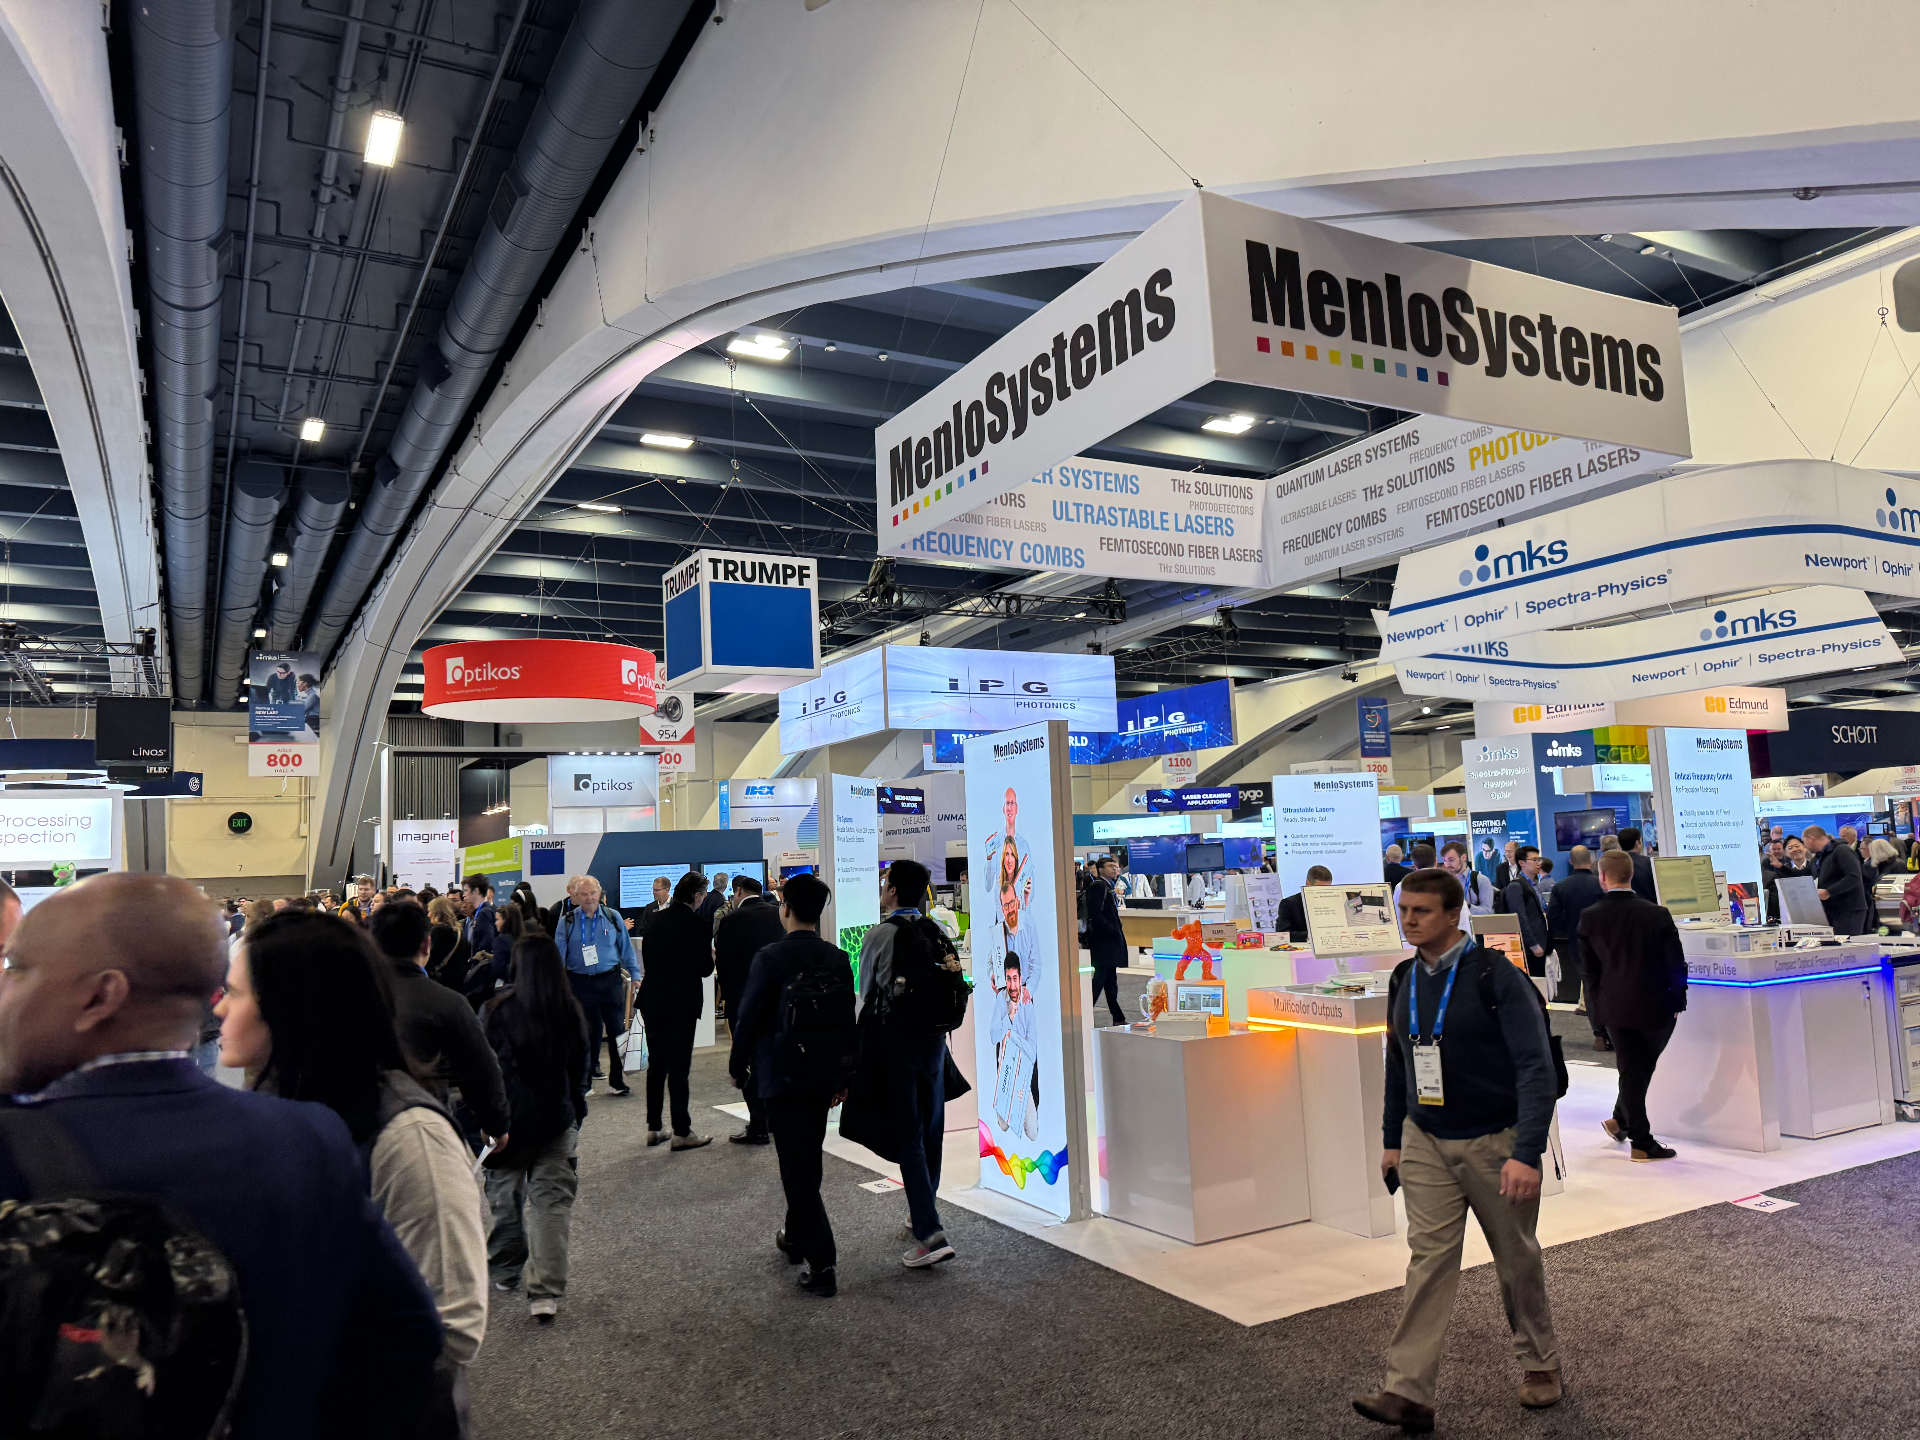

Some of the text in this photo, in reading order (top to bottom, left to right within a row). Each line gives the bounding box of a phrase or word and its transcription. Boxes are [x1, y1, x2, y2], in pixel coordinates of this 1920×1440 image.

[1245, 239, 1665, 402] MenloSystems
[889, 267, 1176, 508] MenloSystems
[1409, 425, 1493, 464] FREQUENCY COMBS
[1469, 431, 1561, 471] PHOTOD
[1275, 430, 1420, 499] QUANTUM LASER SYSTEMS
[1059, 467, 1140, 495] SYSTEMS
[1171, 478, 1253, 500] THz SOLUTIONS
[1362, 456, 1455, 503] THz SOLUTIONS
[1396, 461, 1526, 515] FEMTOSECOND FIBER LASERS
[1425, 447, 1641, 530] FEMTOSECOND FIBER LASERS
[1053, 499, 1234, 537] ULTRASTABLE LASERS
[1189, 500, 1254, 516] PHOTODETECTORS
[1280, 490, 1357, 525] ULTRASTABLE LASERS
[986, 515, 1011, 529] FIBER
[1014, 519, 1047, 533] LASERS
[1282, 508, 1387, 555] FREQUENCY COMBS
[901, 530, 1085, 569] REQUENCY COMBS
[1099, 536, 1263, 563] FEMTOSECOND FIBER LASERS
[1304, 526, 1404, 566] QUANTUM LASER SYSTEMS
[1158, 562, 1216, 576] THz SOLUTIONS
[1494, 539, 1569, 579] mks
[1804, 554, 1912, 577] Newport Ophir
[665, 559, 700, 601] TRUMPF
[708, 558, 810, 586] TRUMPF
[1387, 573, 1668, 645] Newport Ophir Spectra-Physics
[1731, 608, 1797, 637] mks
[1632, 638, 1882, 684] Newport Ophir Spectra-Physics
[449, 657, 520, 687] Optikos
[1406, 669, 1557, 690] Newport Ophir Spectra-Physics
[830, 706, 860, 720] PHOTONICS
[1016, 702, 1076, 710] PHOTONICS
[1729, 697, 1769, 710] Edmund
[658, 729, 677, 740] 954
[1165, 725, 1203, 736] PHOTONICS
[1832, 725, 1878, 744] SCHOTT
[993, 737, 1045, 758] MenloSystems
[1489, 747, 1519, 761] mks
[1559, 744, 1582, 757] mks
[1696, 738, 1743, 750] MenloSystems
[267, 753, 303, 768] 800
[1168, 757, 1192, 767] 1100
[1367, 764, 1388, 773] 1200
[574, 774, 633, 794] Optikos
[745, 786, 776, 795] IDEX
[1314, 780, 1374, 790] MenloSystems
[1483, 779, 1517, 788] Newport
[1490, 792, 1511, 800] Ophir
[232, 818, 247, 828] EXIT
[1472, 820, 1500, 828] STARTING
[531, 841, 565, 849] TRUMPF
[238, 864, 243, 872] 7
[1688, 962, 1737, 977] Every Pulse
[1774, 959, 1797, 972] Compact
[1797, 957, 1814, 970] Optical
[1814, 955, 1840, 969] Frequency
[1274, 998, 1343, 1019] Multicolor Outputs
